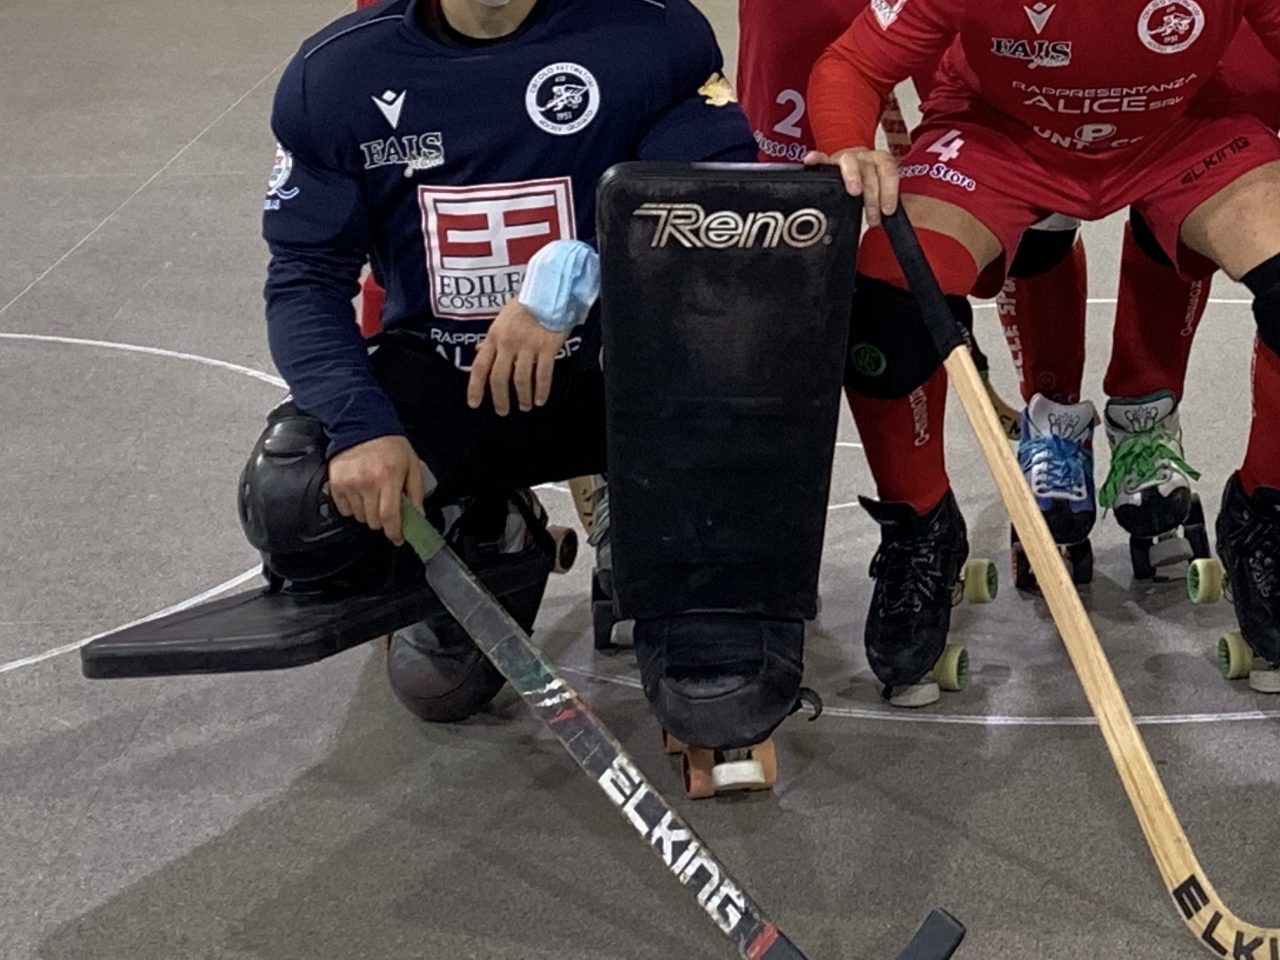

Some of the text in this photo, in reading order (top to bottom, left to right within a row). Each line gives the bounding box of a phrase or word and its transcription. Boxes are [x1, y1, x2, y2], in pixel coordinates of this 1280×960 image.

[773, 89, 806, 138] 2
[1023, 95, 1147, 114] ALICE
[925, 129, 965, 162] 4
[929, 163, 976, 192] Store
[632, 202, 828, 249] Reno
[438, 272, 526, 296] EDILF
[598, 752, 746, 934] ELKING
